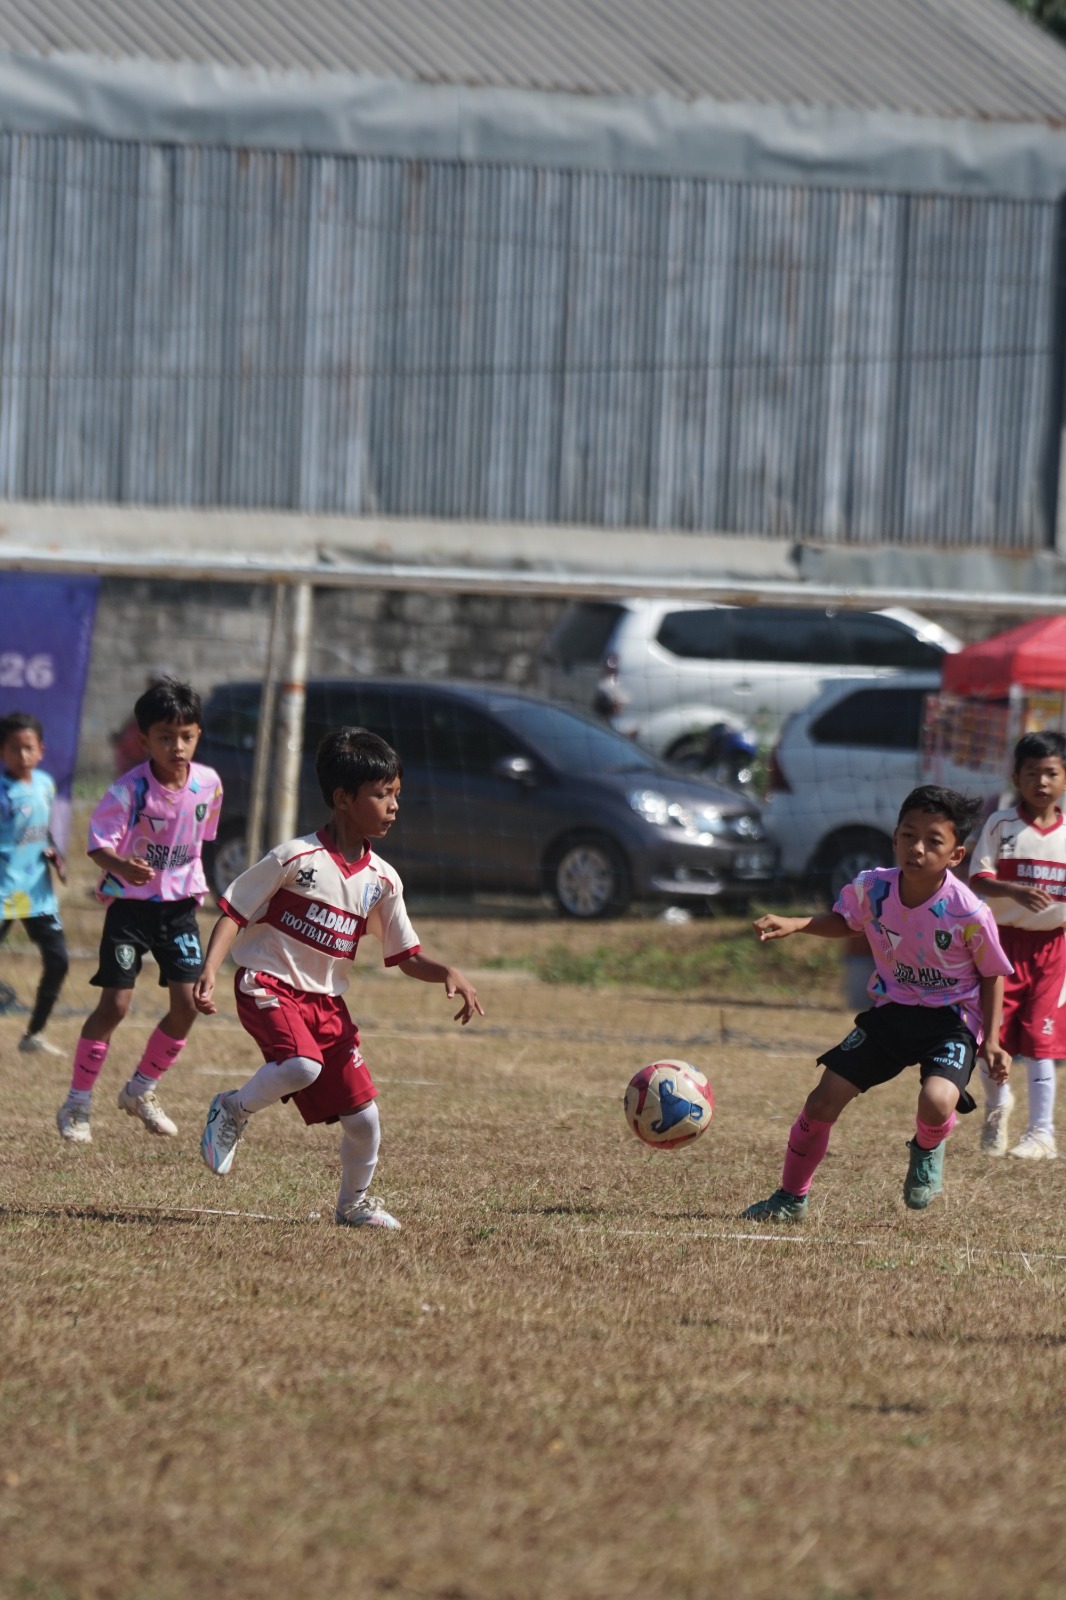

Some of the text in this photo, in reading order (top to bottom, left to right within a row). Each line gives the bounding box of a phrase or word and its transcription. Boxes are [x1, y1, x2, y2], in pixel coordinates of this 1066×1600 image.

[280, 910, 333, 948] FOOTBALL
[305, 902, 358, 936] BADRAN
[173, 932, 201, 959] 14
[944, 1041, 966, 1065] 11
